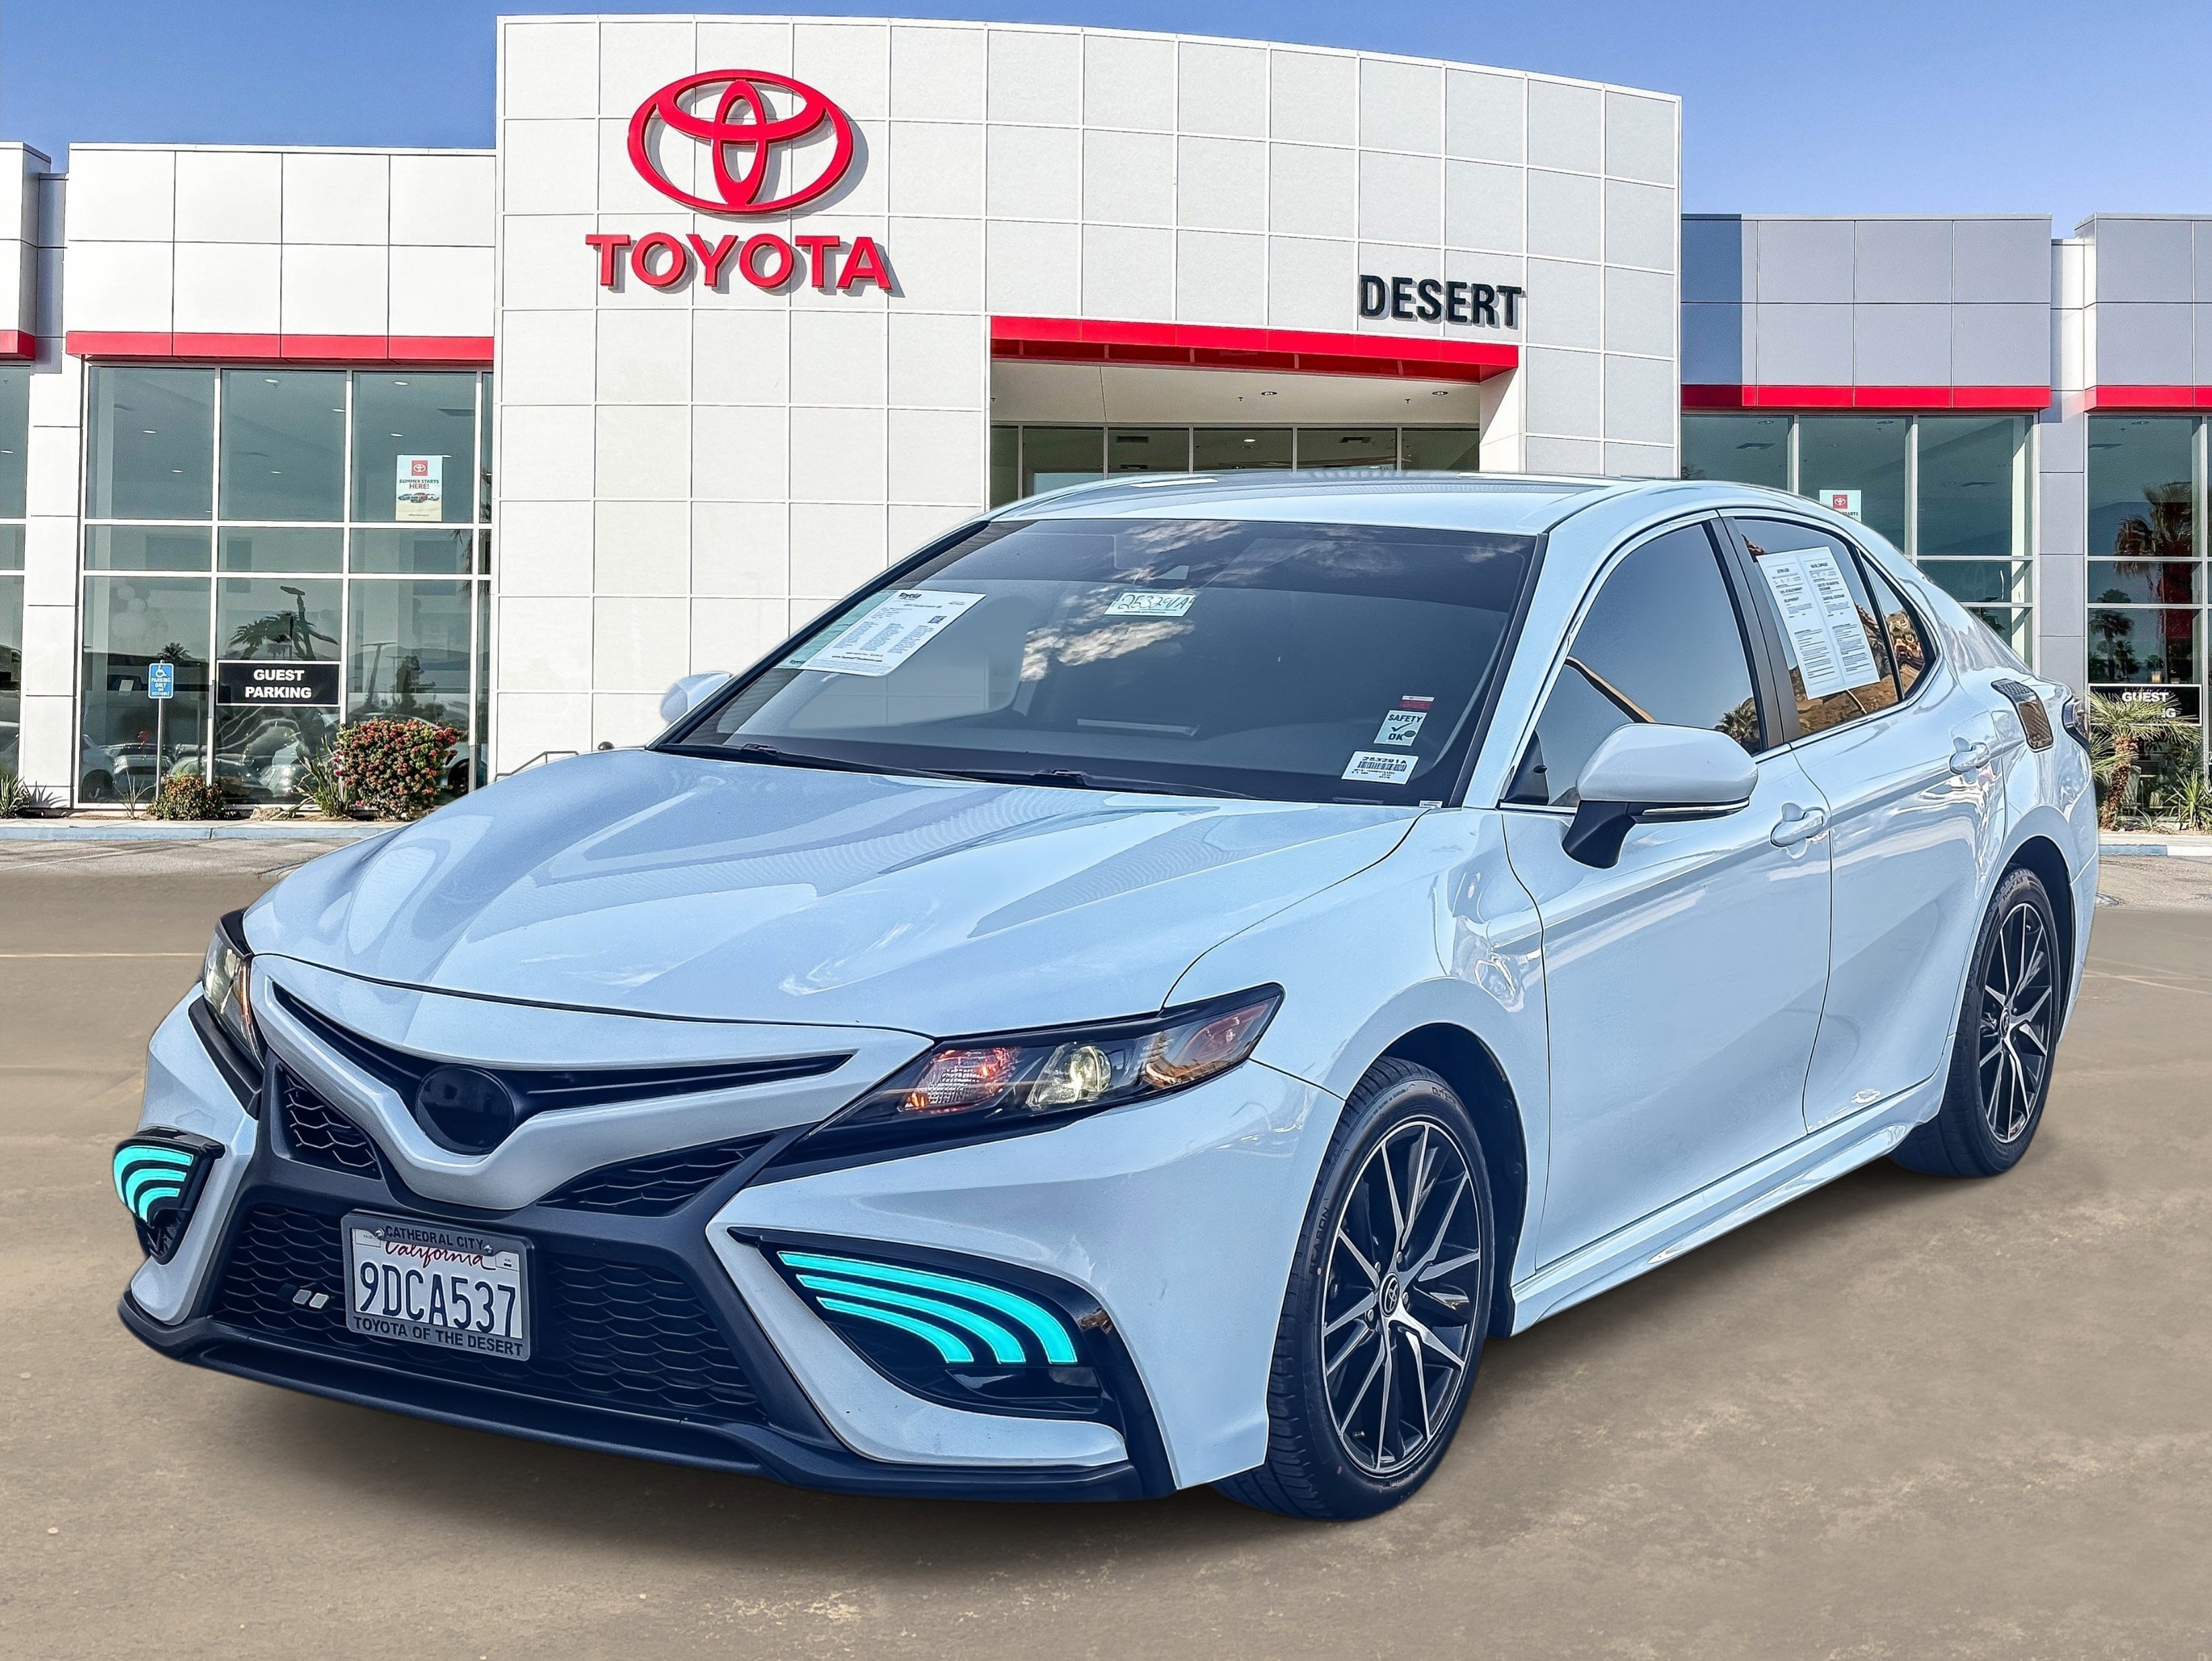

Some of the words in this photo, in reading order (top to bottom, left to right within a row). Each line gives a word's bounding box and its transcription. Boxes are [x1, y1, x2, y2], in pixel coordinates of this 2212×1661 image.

[585, 232, 893, 290] TOYOTA
[1359, 274, 1522, 327] DESERT
[253, 669, 305, 681] GUEST
[245, 686, 312, 699] PARKING
[1388, 714, 1423, 723] SAFETY
[1389, 733, 1404, 741] OK
[385, 1225, 454, 1246] CATHEDRAL
[457, 1236, 485, 1251] CITY
[385, 1241, 497, 1270] California
[360, 1261, 516, 1338] 9DCA537
[353, 1315, 408, 1338] TOYOTA
[412, 1326, 431, 1340] OF
[435, 1329, 464, 1347] THE
[468, 1334, 523, 1357] DESERT
